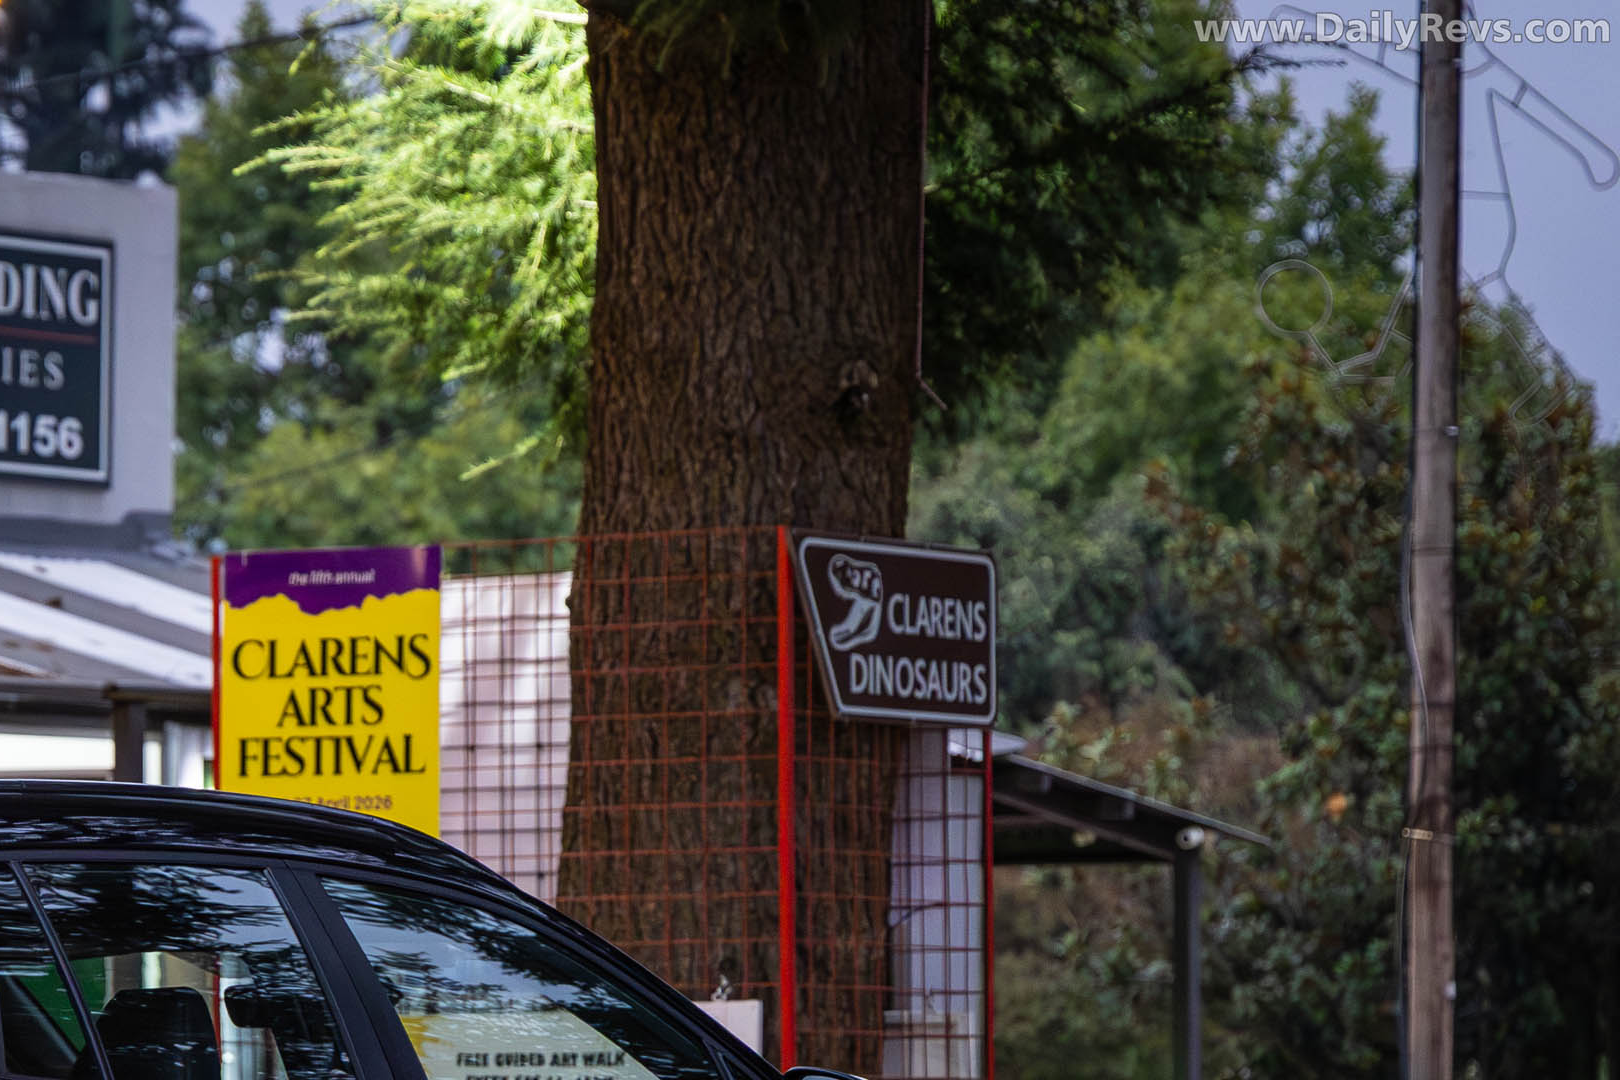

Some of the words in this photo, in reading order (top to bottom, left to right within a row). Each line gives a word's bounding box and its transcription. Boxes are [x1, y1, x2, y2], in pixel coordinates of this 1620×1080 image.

[887, 592, 988, 643] CLARENS
[232, 633, 431, 680] CLARENS
[849, 653, 988, 704] DINOSAURS
[277, 685, 384, 728] ARTS
[238, 733, 426, 778] FESTIVAL
[550, 1051, 578, 1067] ART
[583, 1050, 626, 1067] WALK
